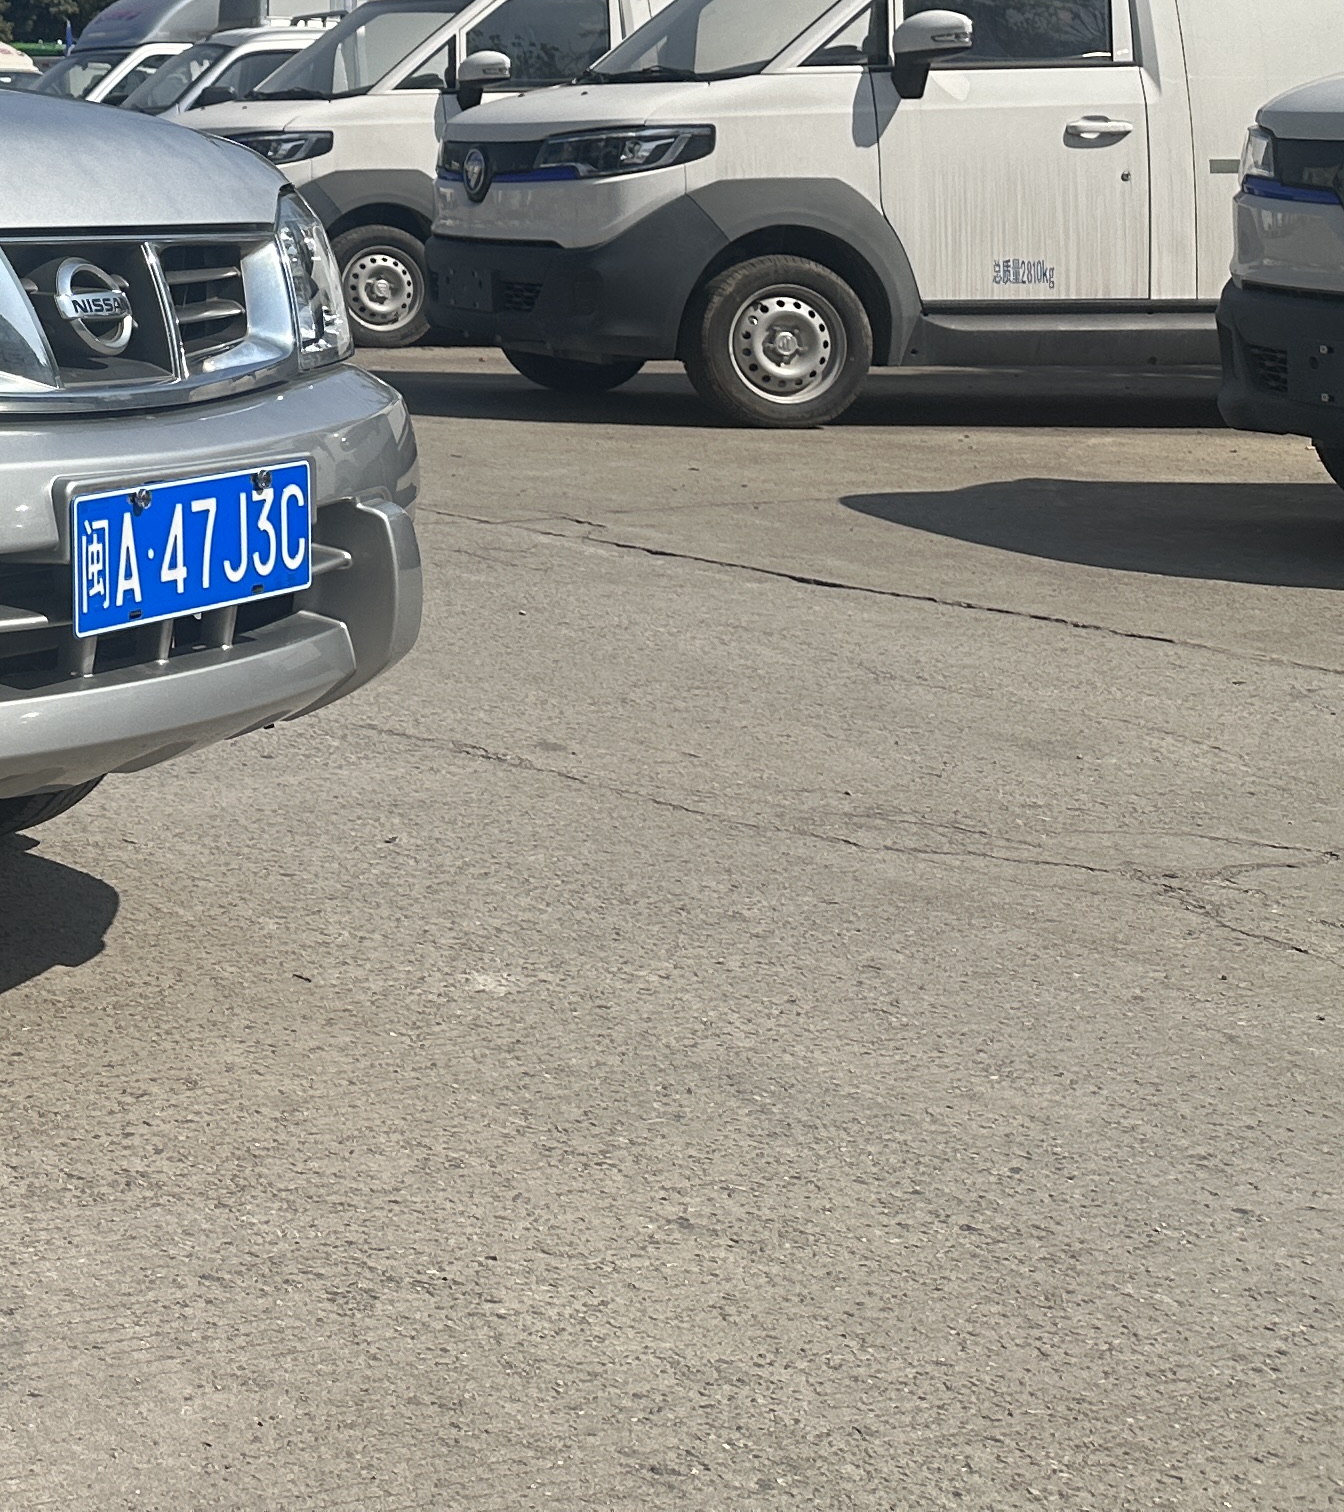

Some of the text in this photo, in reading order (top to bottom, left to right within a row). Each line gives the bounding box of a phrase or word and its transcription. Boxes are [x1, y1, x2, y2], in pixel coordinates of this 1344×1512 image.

[993, 258, 1055, 289] 总质量2810kg
[82, 484, 305, 614] 闽A·47J3C
